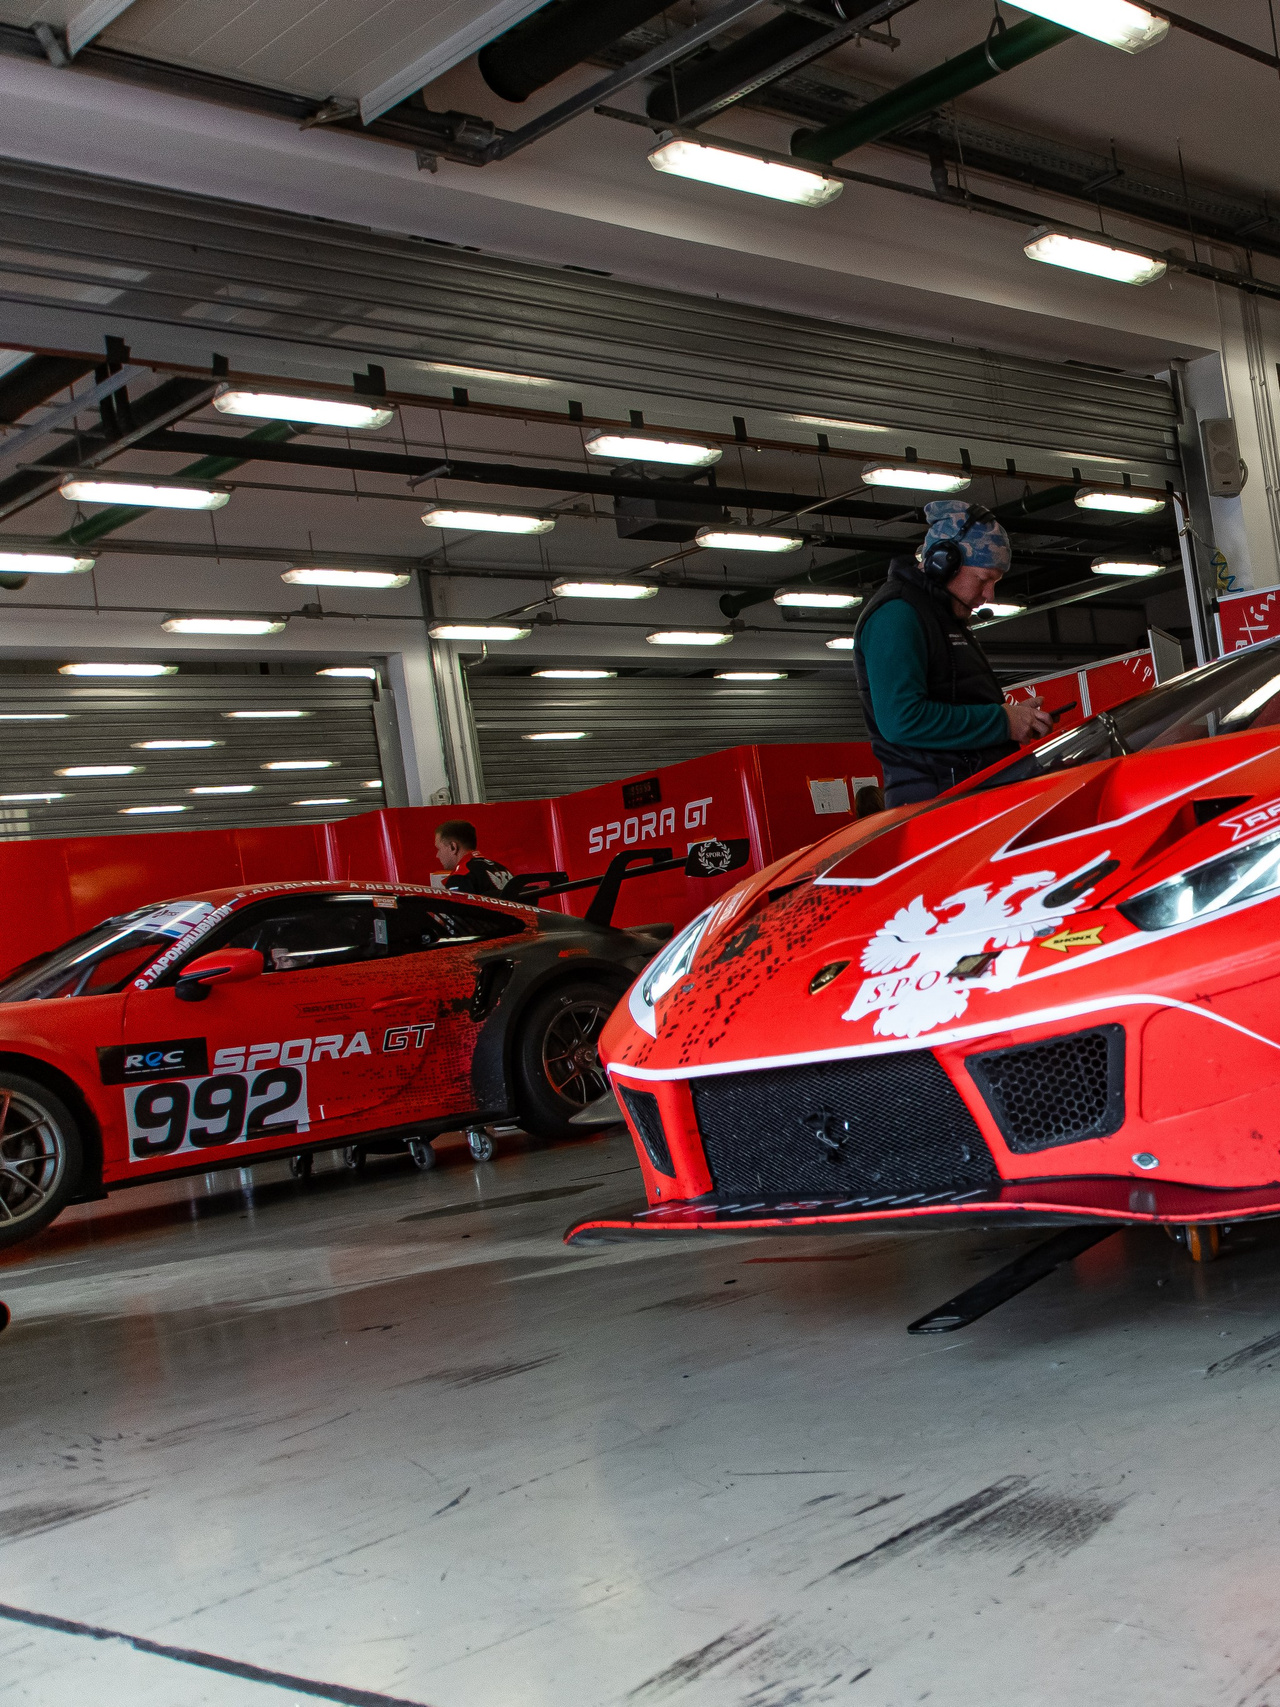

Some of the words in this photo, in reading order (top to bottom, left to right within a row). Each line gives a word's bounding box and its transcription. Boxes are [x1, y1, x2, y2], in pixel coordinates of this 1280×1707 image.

[588, 806, 676, 854] SPORA
[684, 796, 713, 830] GT
[705, 850, 725, 859] SPORA
[350, 882, 452, 896] А.ДЕВЯКОВИЧ
[467, 894, 541, 913] А.КОСАРЕВ
[134, 904, 234, 991] Э.ТАРОНИШВИЛИ
[302, 1002, 361, 1013] RAVENOL
[212, 1031, 372, 1076] SPORA
[382, 1022, 435, 1054] GT
[132, 1066, 303, 1160] 992
